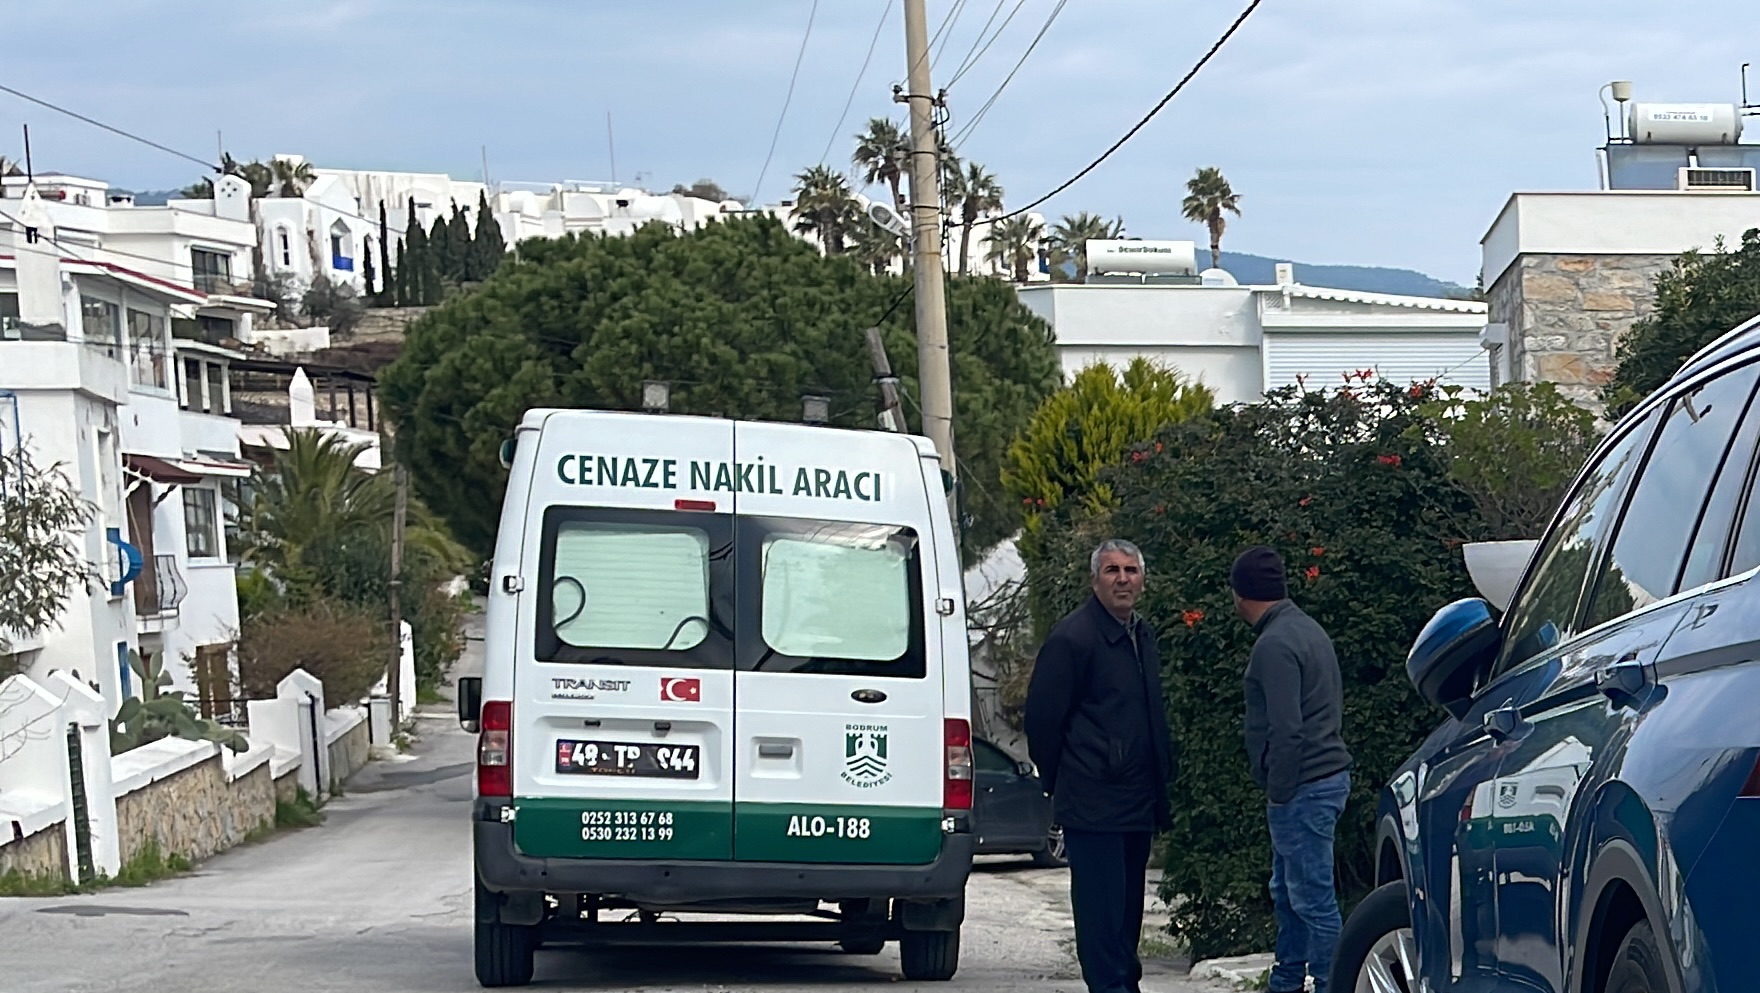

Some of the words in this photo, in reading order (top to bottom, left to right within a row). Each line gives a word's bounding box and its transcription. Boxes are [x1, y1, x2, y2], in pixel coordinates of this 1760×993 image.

[557, 454, 677, 489] CENAZE
[689, 455, 783, 495] NAKİL
[792, 467, 882, 502] ARACI
[551, 678, 631, 691] TRANSIT
[845, 724, 888, 732] BODRUM
[581, 811, 612, 825] 0252
[614, 811, 638, 825] 313
[640, 812, 656, 825] 67
[658, 812, 674, 825] 68
[581, 826, 612, 840] 0530
[614, 827, 638, 840] 232
[641, 827, 656, 840] 13
[658, 827, 674, 840] 99
[786, 815, 871, 839] ALO-188
